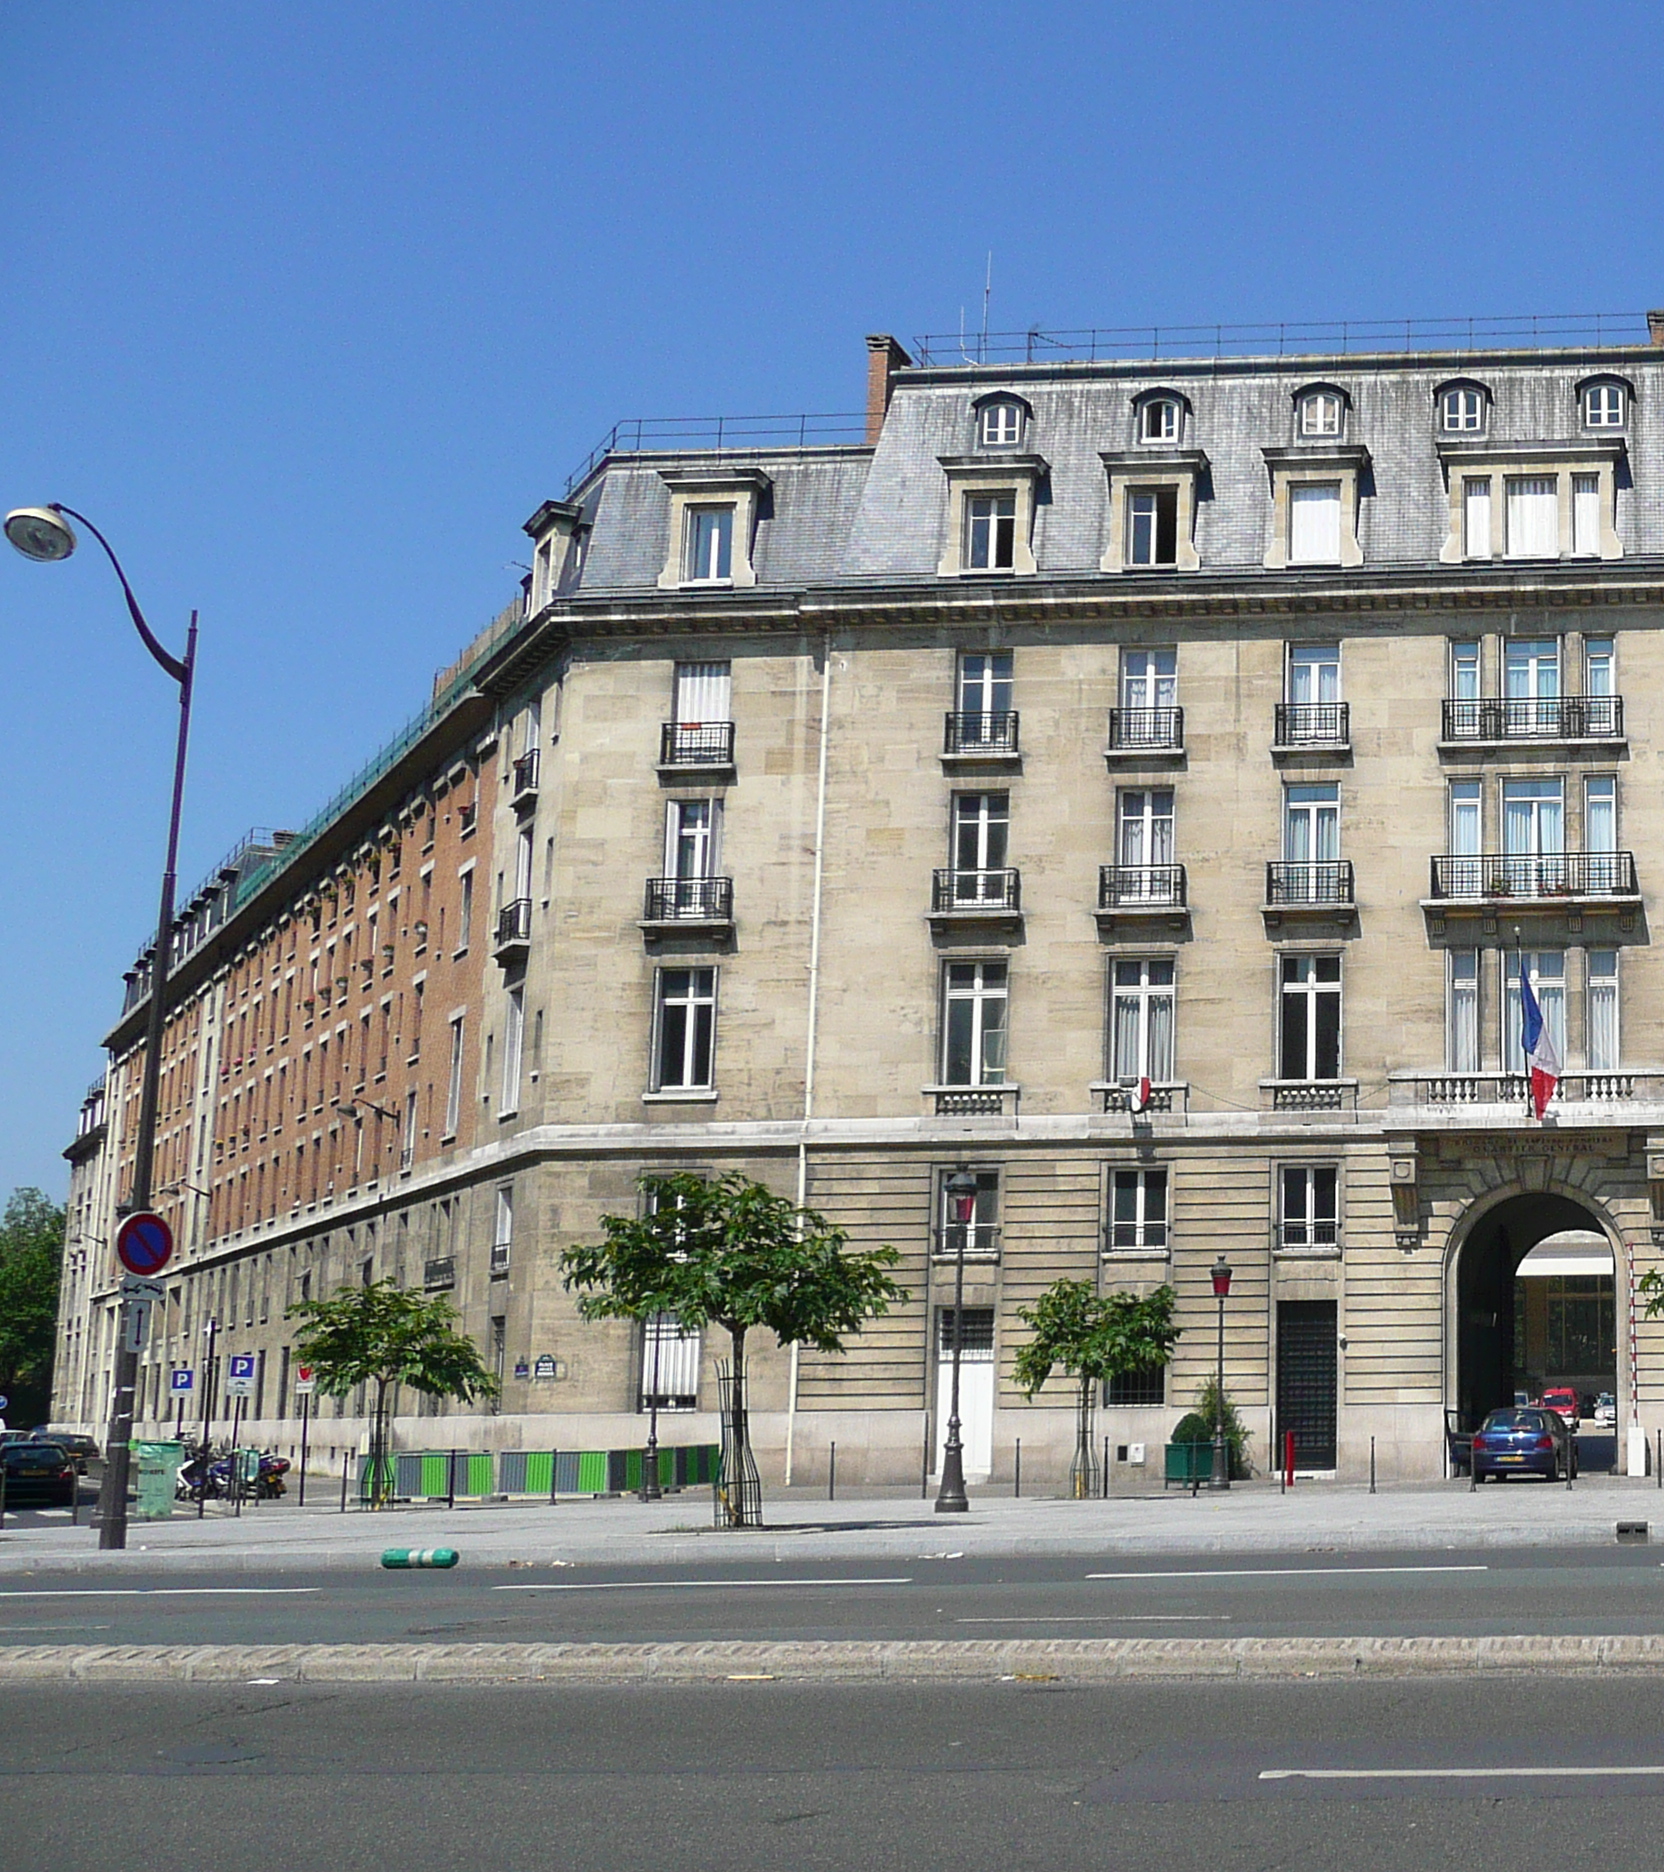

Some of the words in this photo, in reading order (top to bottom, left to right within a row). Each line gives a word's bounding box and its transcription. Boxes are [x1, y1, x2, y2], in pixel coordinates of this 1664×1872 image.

[1472, 1145, 1537, 1153] QUARTIER
[235, 1360, 249, 1374] P
[176, 1373, 189, 1387] P
